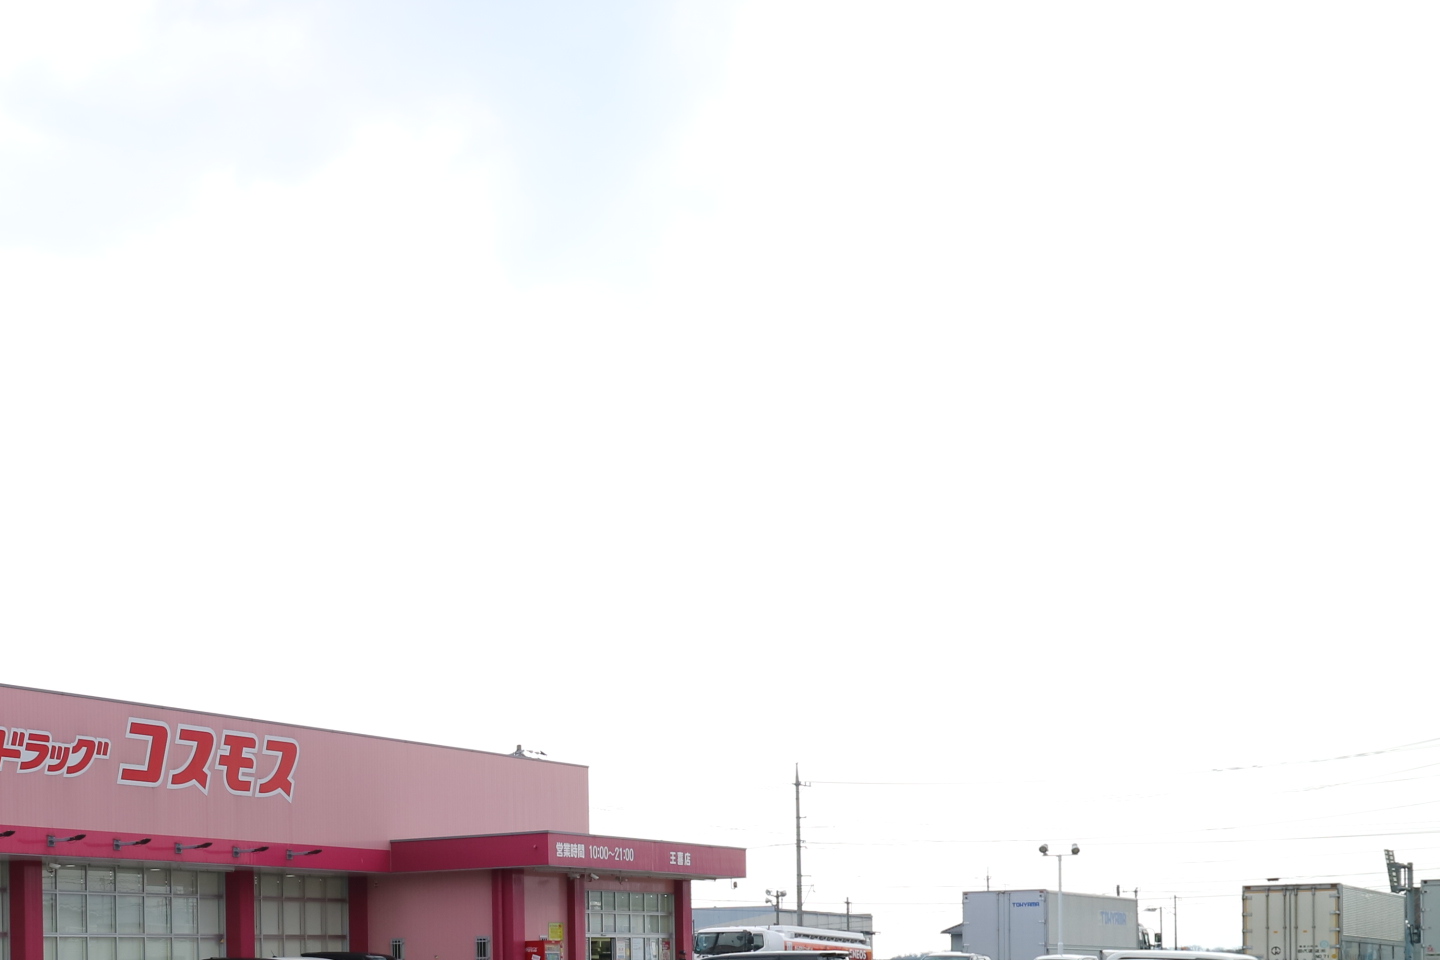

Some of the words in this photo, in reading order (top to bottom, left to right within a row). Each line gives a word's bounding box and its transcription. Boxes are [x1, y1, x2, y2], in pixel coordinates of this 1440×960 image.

[117, 716, 300, 803] コスモス
[556, 842, 585, 859] 営業時間
[669, 851, 691, 866] 王喜店
[849, 948, 867, 960] ENEOS
